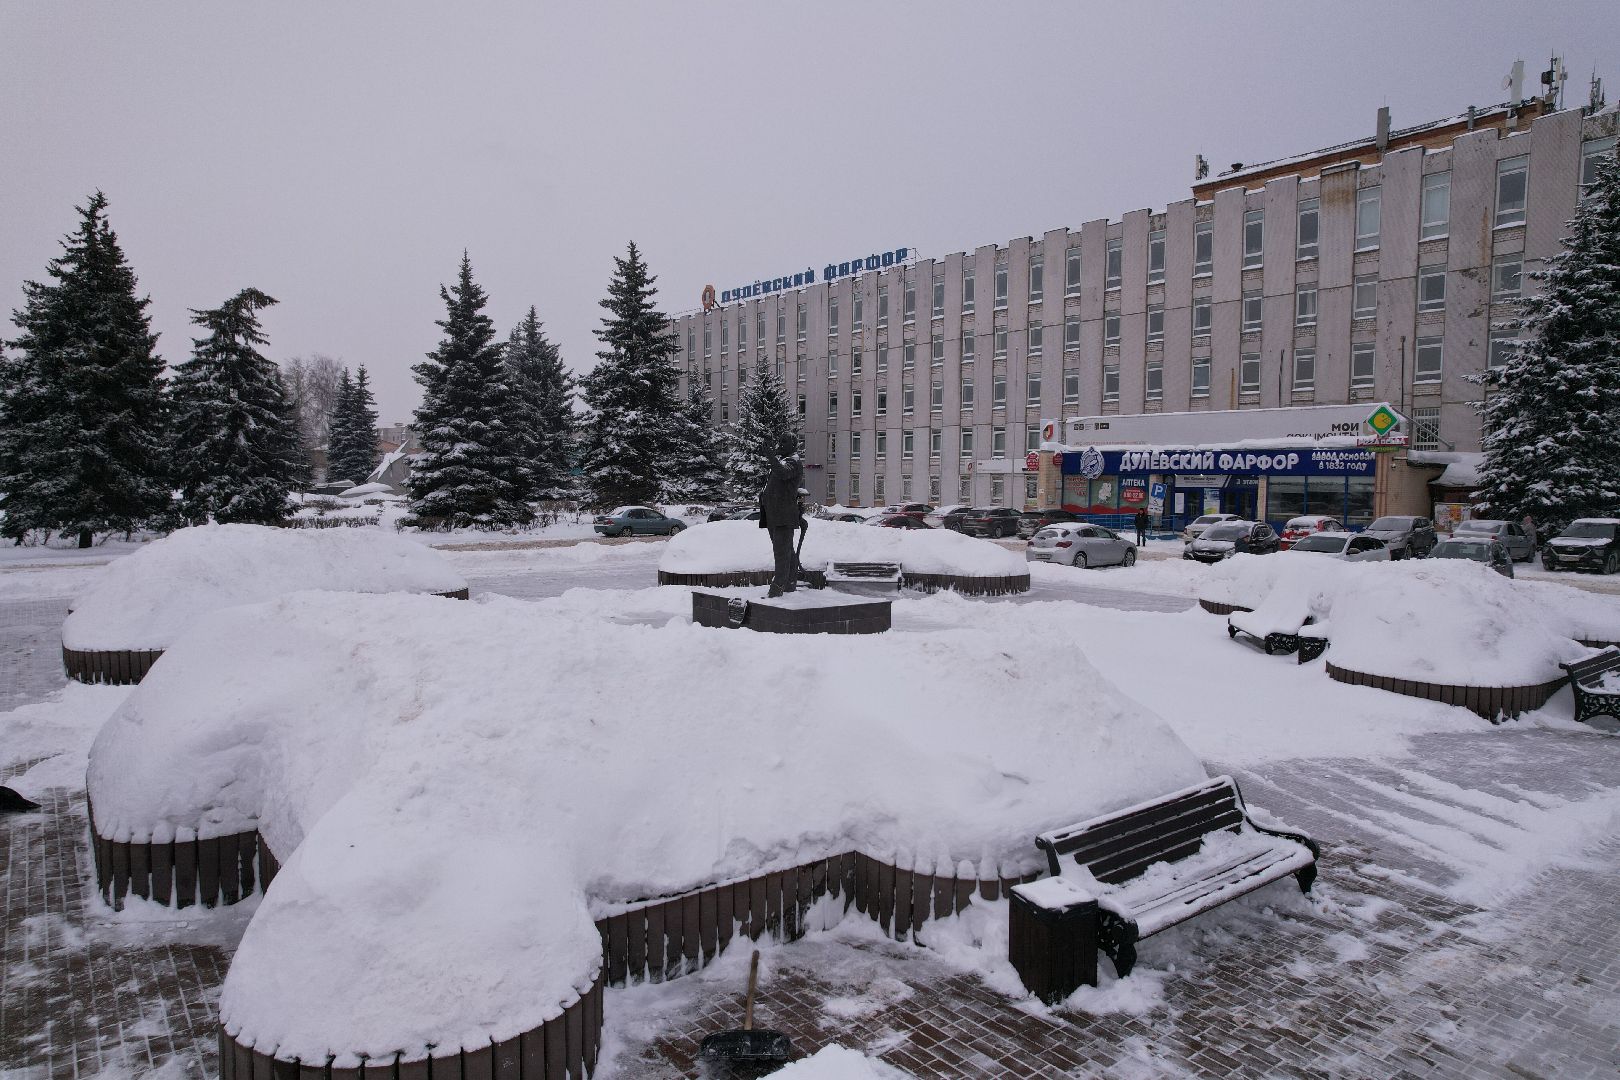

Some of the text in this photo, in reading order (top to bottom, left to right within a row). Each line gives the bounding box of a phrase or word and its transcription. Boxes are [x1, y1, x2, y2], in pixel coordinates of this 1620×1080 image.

[721, 248, 908, 303] ДУЛЁВСКИЙ ФАРФОР
[1218, 452, 1300, 470] ФАРФОР
[1121, 479, 1146, 487] АПТЕКА
